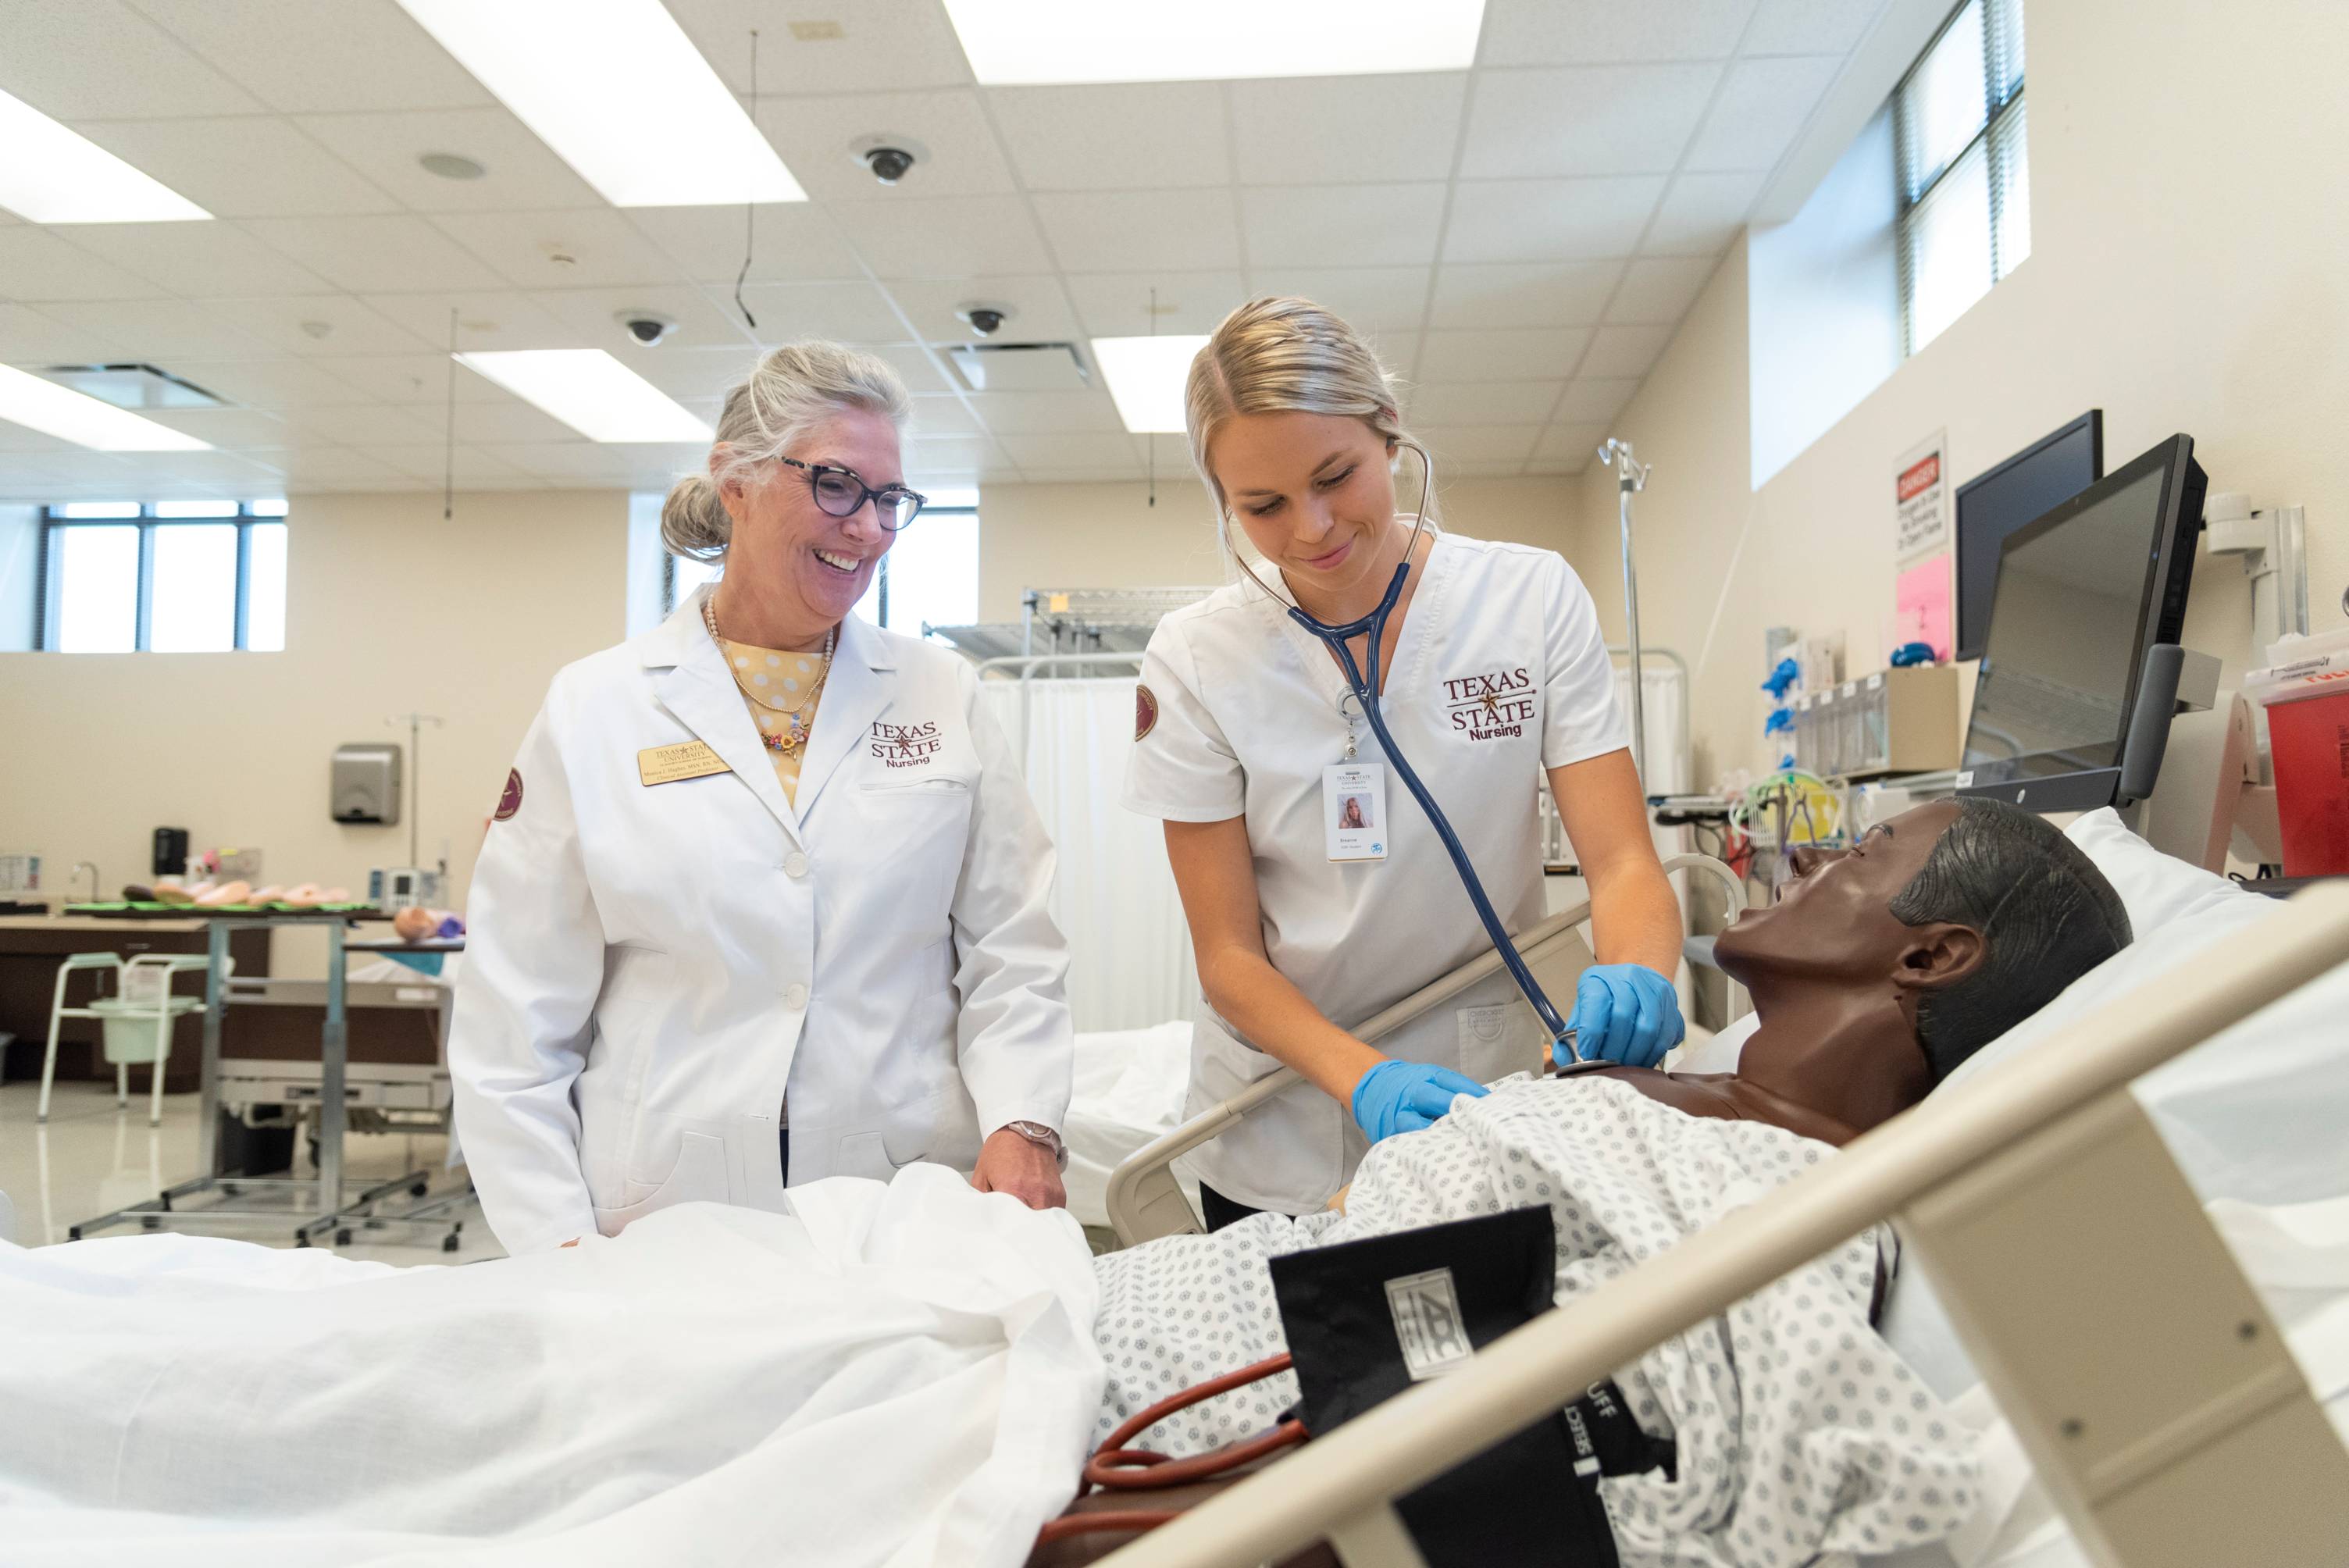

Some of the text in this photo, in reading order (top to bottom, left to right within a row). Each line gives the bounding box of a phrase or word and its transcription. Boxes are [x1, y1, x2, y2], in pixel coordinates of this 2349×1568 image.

[1898, 459, 1937, 495] DANGER
[1443, 668, 1530, 700] TEXAS
[1451, 700, 1535, 730] STATE
[872, 721, 936, 739] TEXAS
[1469, 724, 1522, 741] Nursing
[656, 743, 708, 758] TEXAS STAT
[664, 750, 706, 763] UNIVERSITY
[872, 739, 941, 759] STATE
[886, 757, 930, 768] Nursing
[1587, 1380, 1619, 1418] UFF
